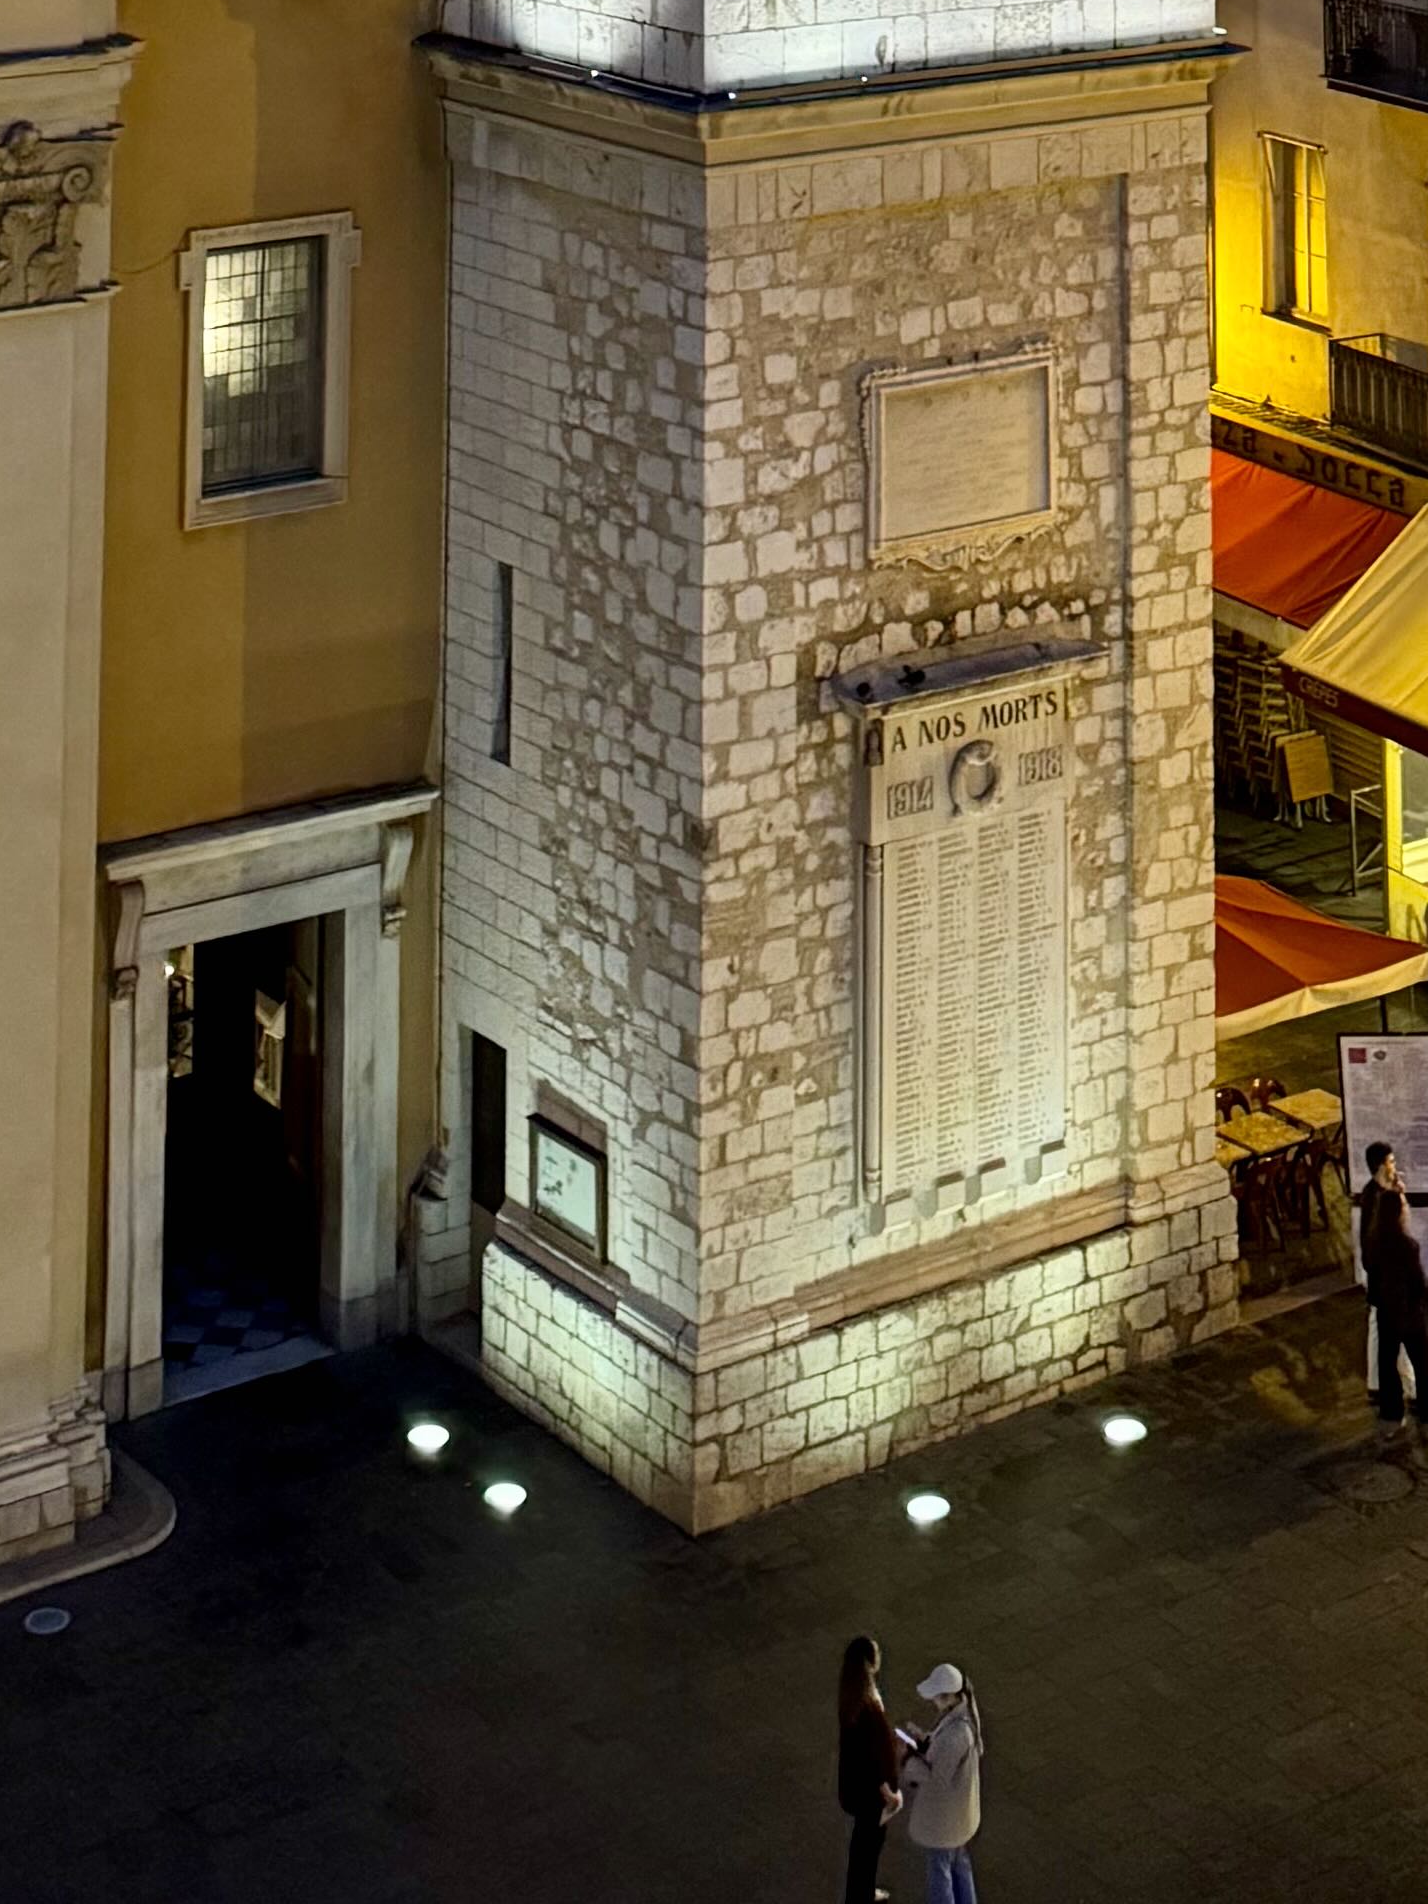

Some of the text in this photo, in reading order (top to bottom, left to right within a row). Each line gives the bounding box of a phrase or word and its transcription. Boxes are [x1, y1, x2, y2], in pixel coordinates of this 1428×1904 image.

[891, 691, 1058, 754] A NOS MORTS
[1017, 744, 1063, 787] 1918
[886, 776, 934, 820] 1914
